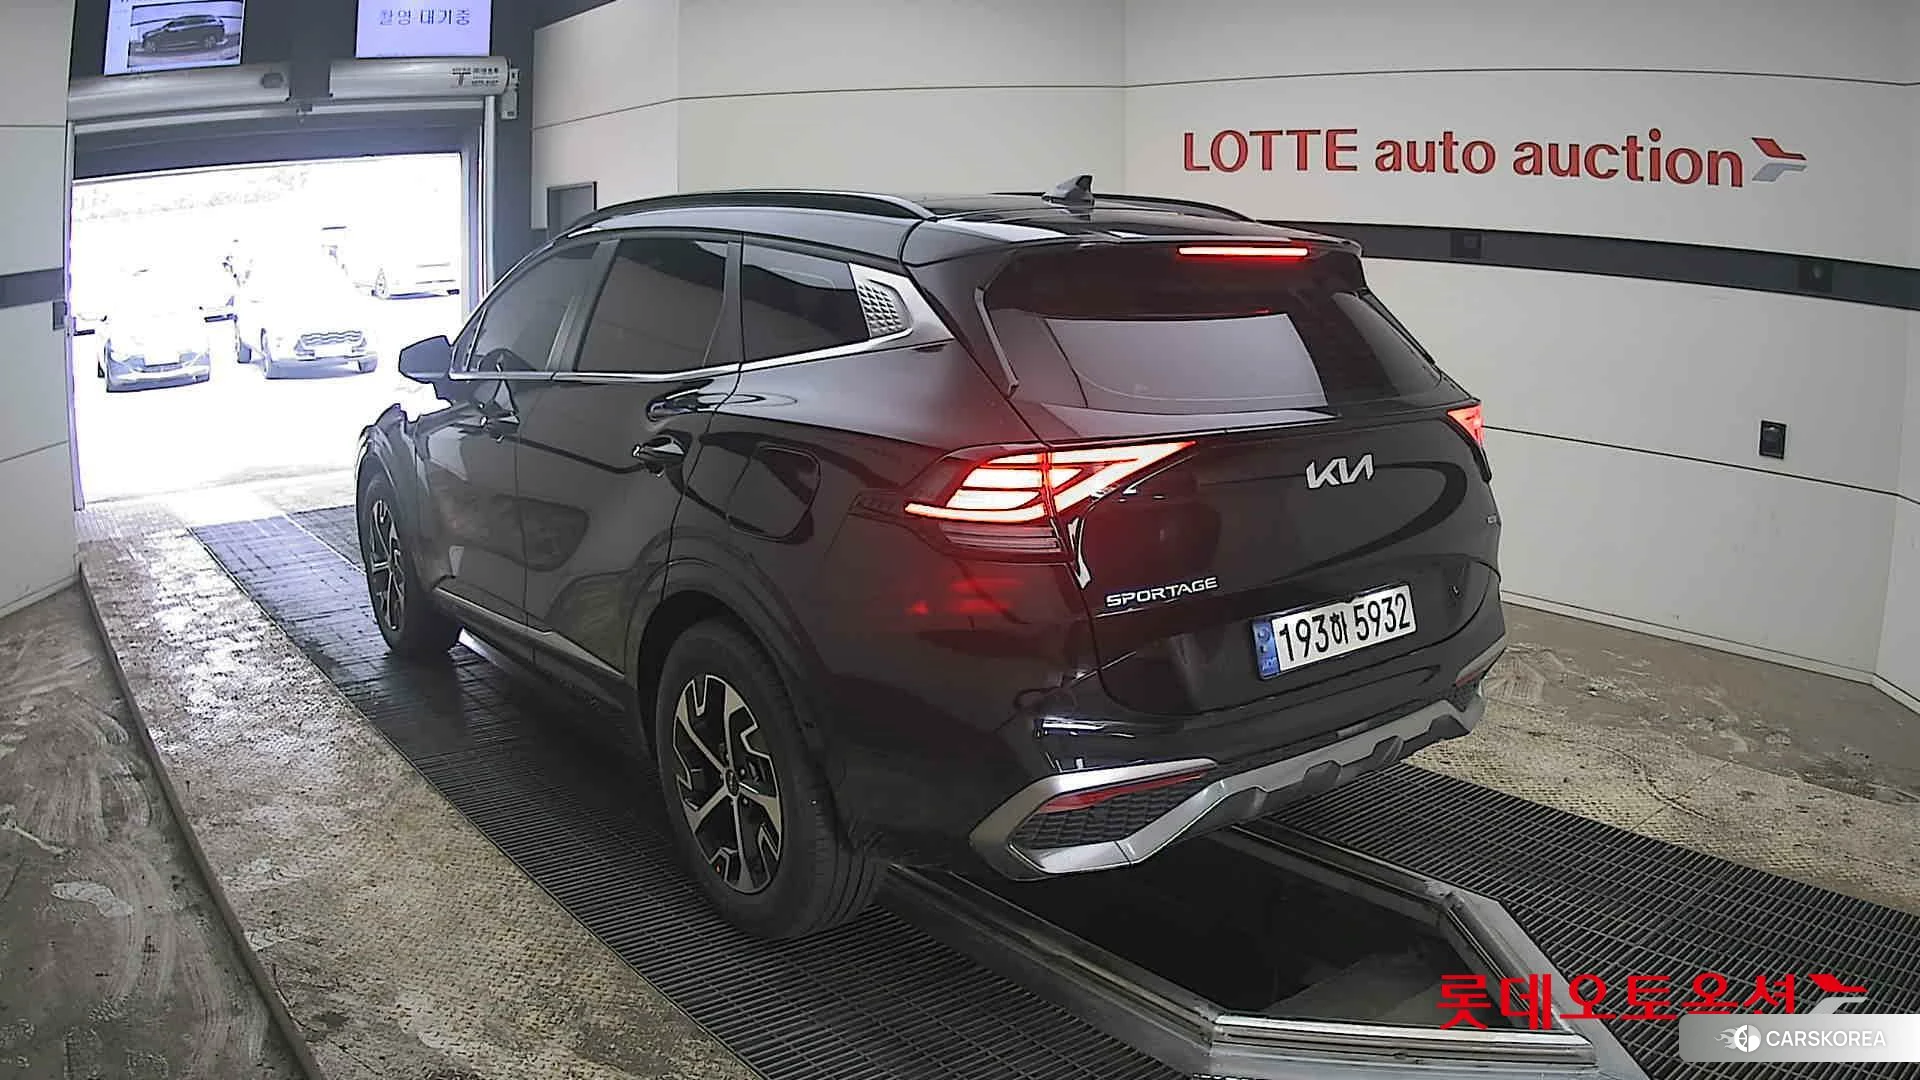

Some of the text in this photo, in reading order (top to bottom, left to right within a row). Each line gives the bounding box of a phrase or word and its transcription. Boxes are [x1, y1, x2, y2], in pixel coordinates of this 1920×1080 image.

[420, 9, 471, 26] 대기중
[1183, 127, 1744, 188] LOTTE auto auction
[1105, 576, 1218, 607] SPORTAGE
